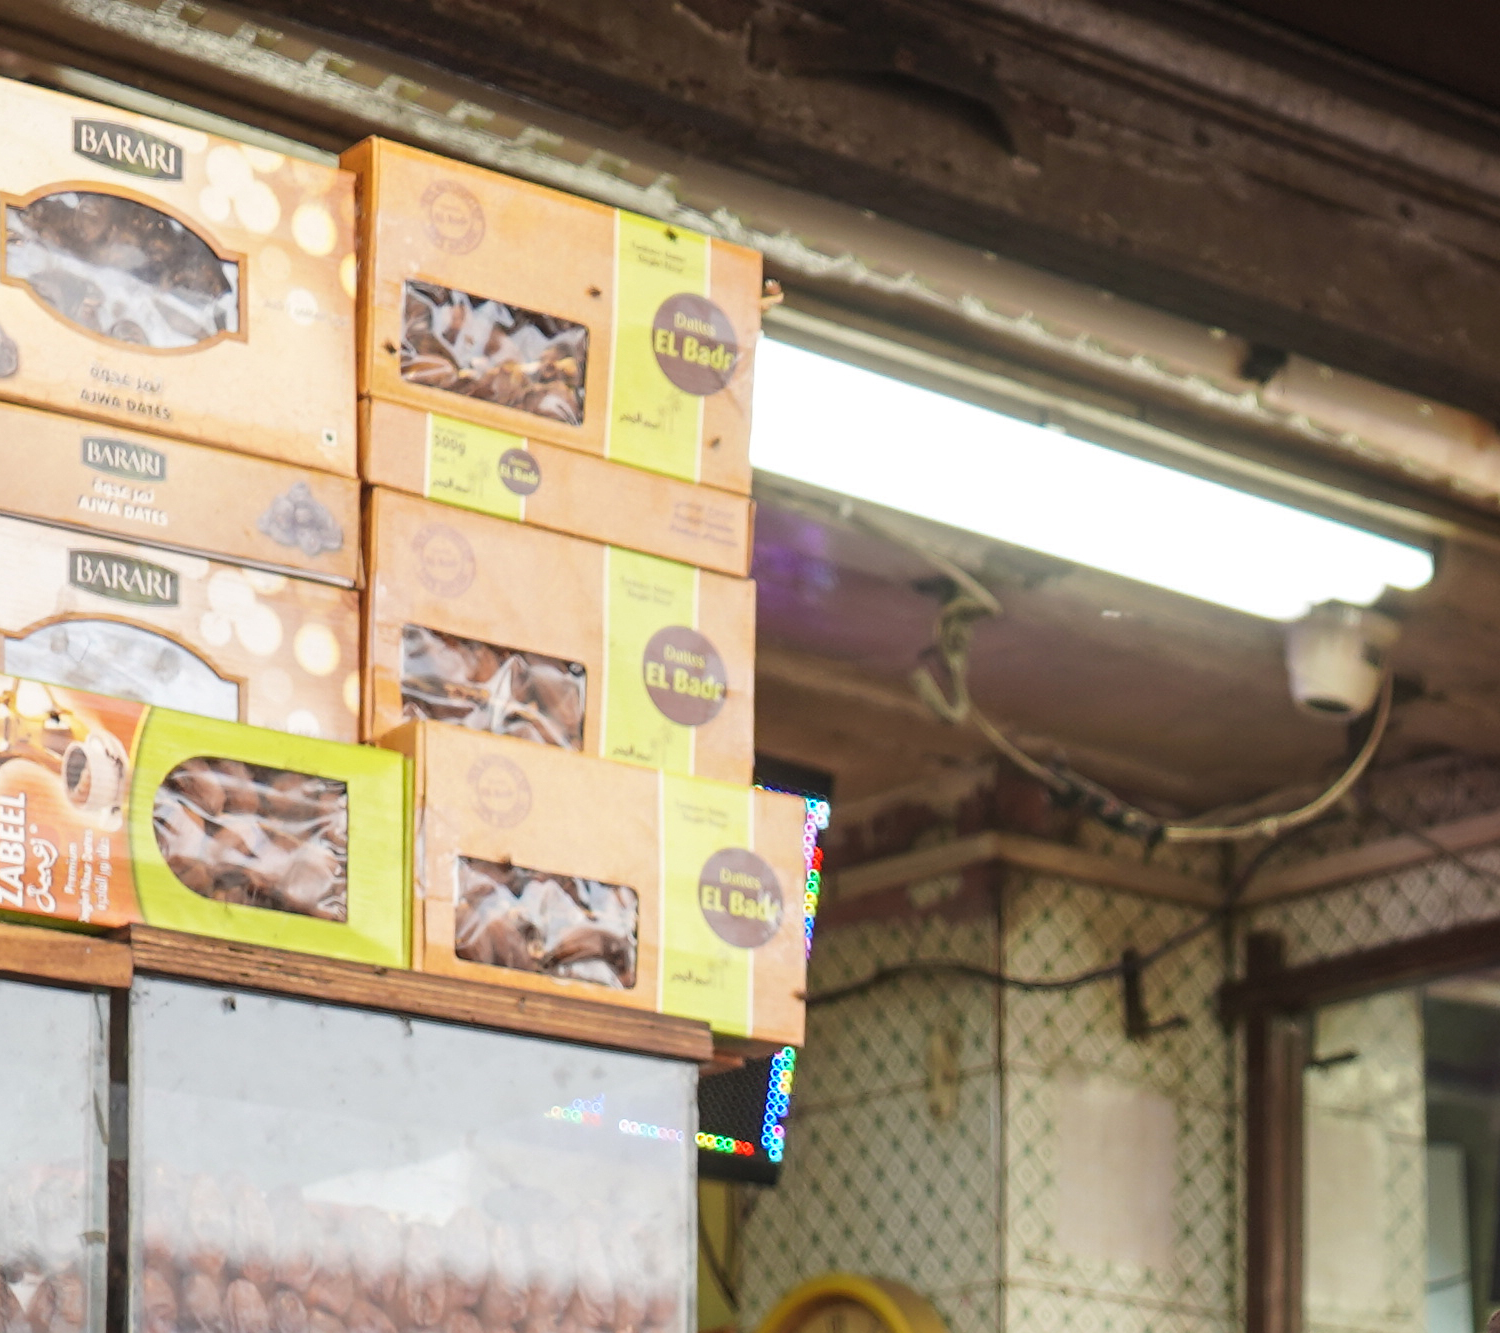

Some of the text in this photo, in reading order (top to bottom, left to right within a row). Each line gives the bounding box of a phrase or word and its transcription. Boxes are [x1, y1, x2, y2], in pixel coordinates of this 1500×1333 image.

[79, 122, 176, 176] BARARI
[674, 311, 717, 337] Dattes
[655, 328, 735, 371] EL Badr
[80, 388, 172, 421] AJWA DATES
[86, 439, 161, 478] BARARI
[78, 495, 169, 527] AJWA DATES
[76, 555, 172, 601] BARARI
[663, 643, 707, 668] Dattes
[645, 661, 675, 691] EL
[63, 842, 79, 896] Premium
[701, 884, 729, 913] EL
